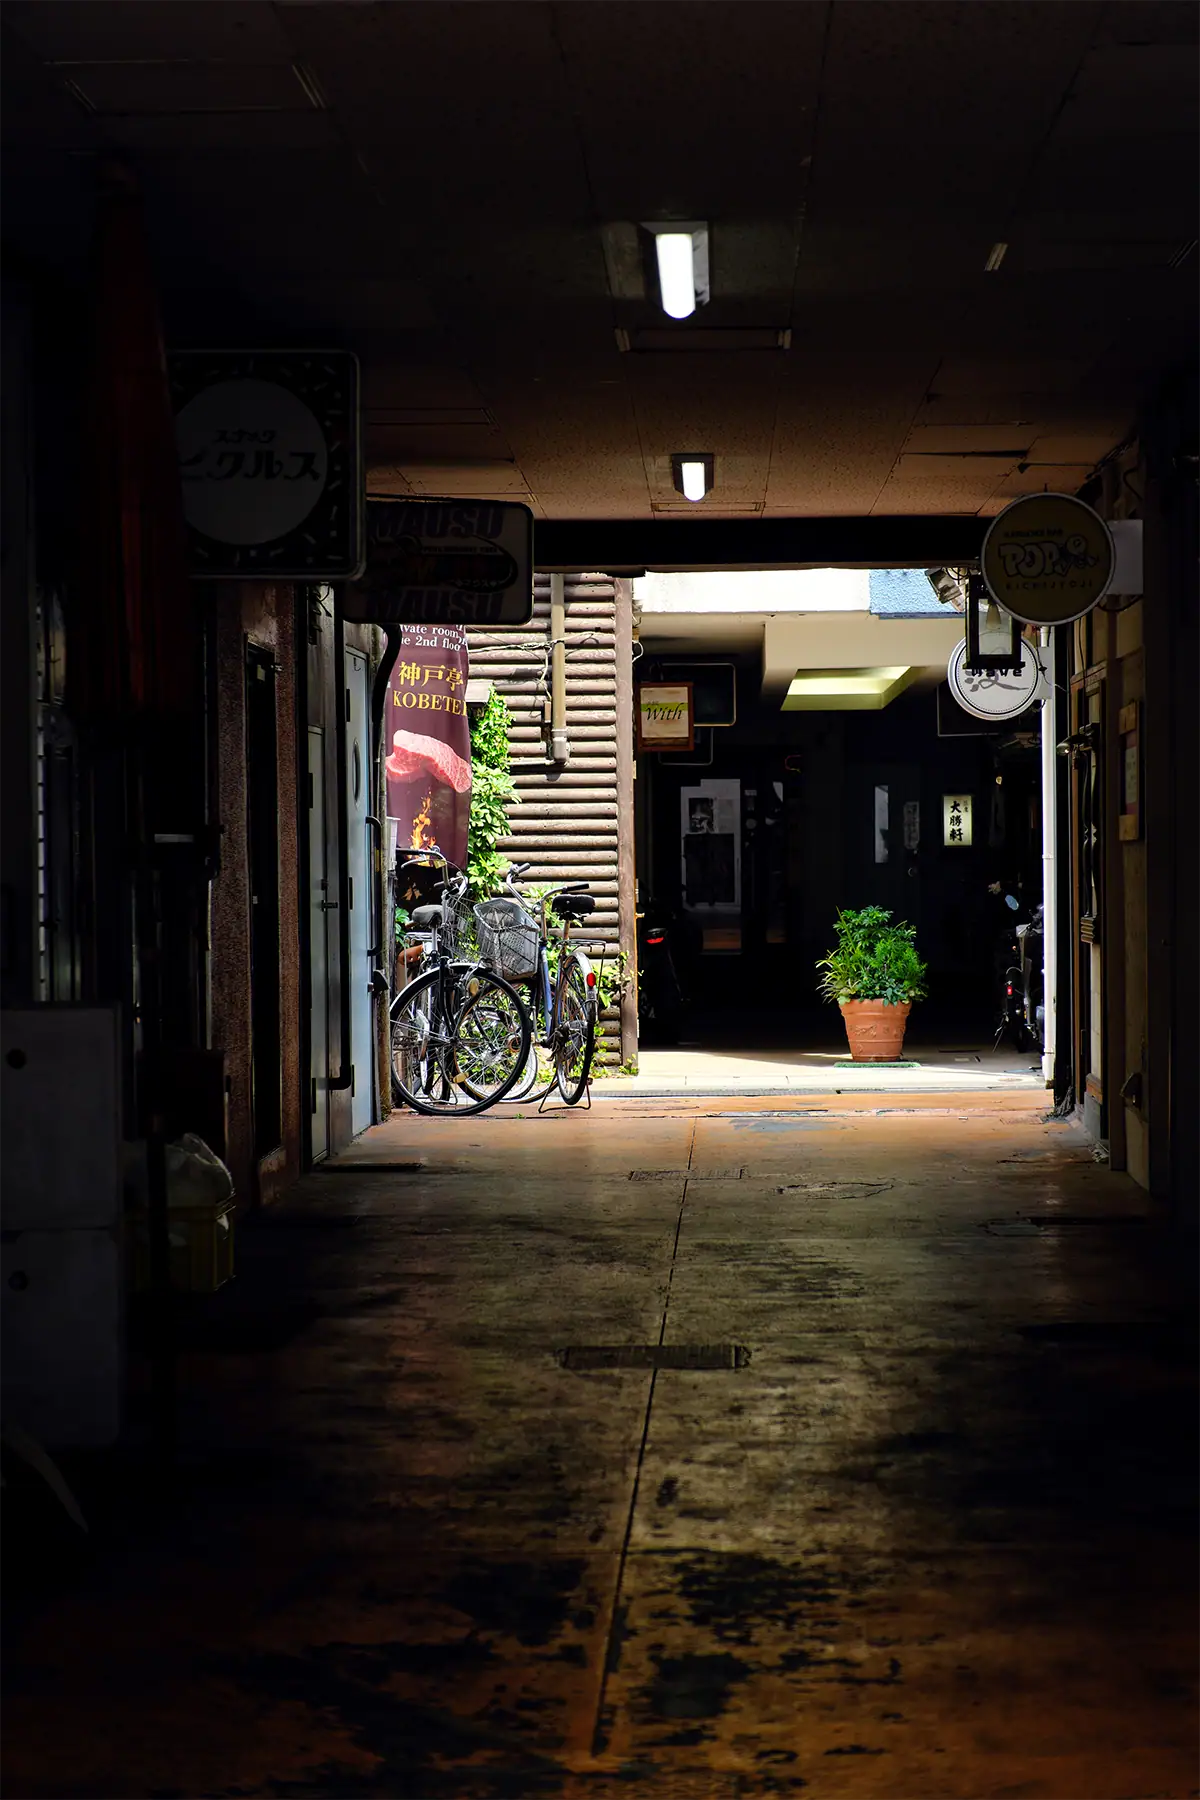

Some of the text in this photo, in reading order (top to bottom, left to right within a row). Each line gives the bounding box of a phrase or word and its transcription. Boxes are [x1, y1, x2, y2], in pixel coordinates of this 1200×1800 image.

[400, 624, 427, 634] ivate
[415, 635, 437, 647] 2nd
[442, 637, 461, 651] floo
[398, 661, 464, 691] 神戸亭
[645, 702, 685, 720] With
[949, 800, 963, 841] 大勝軒
